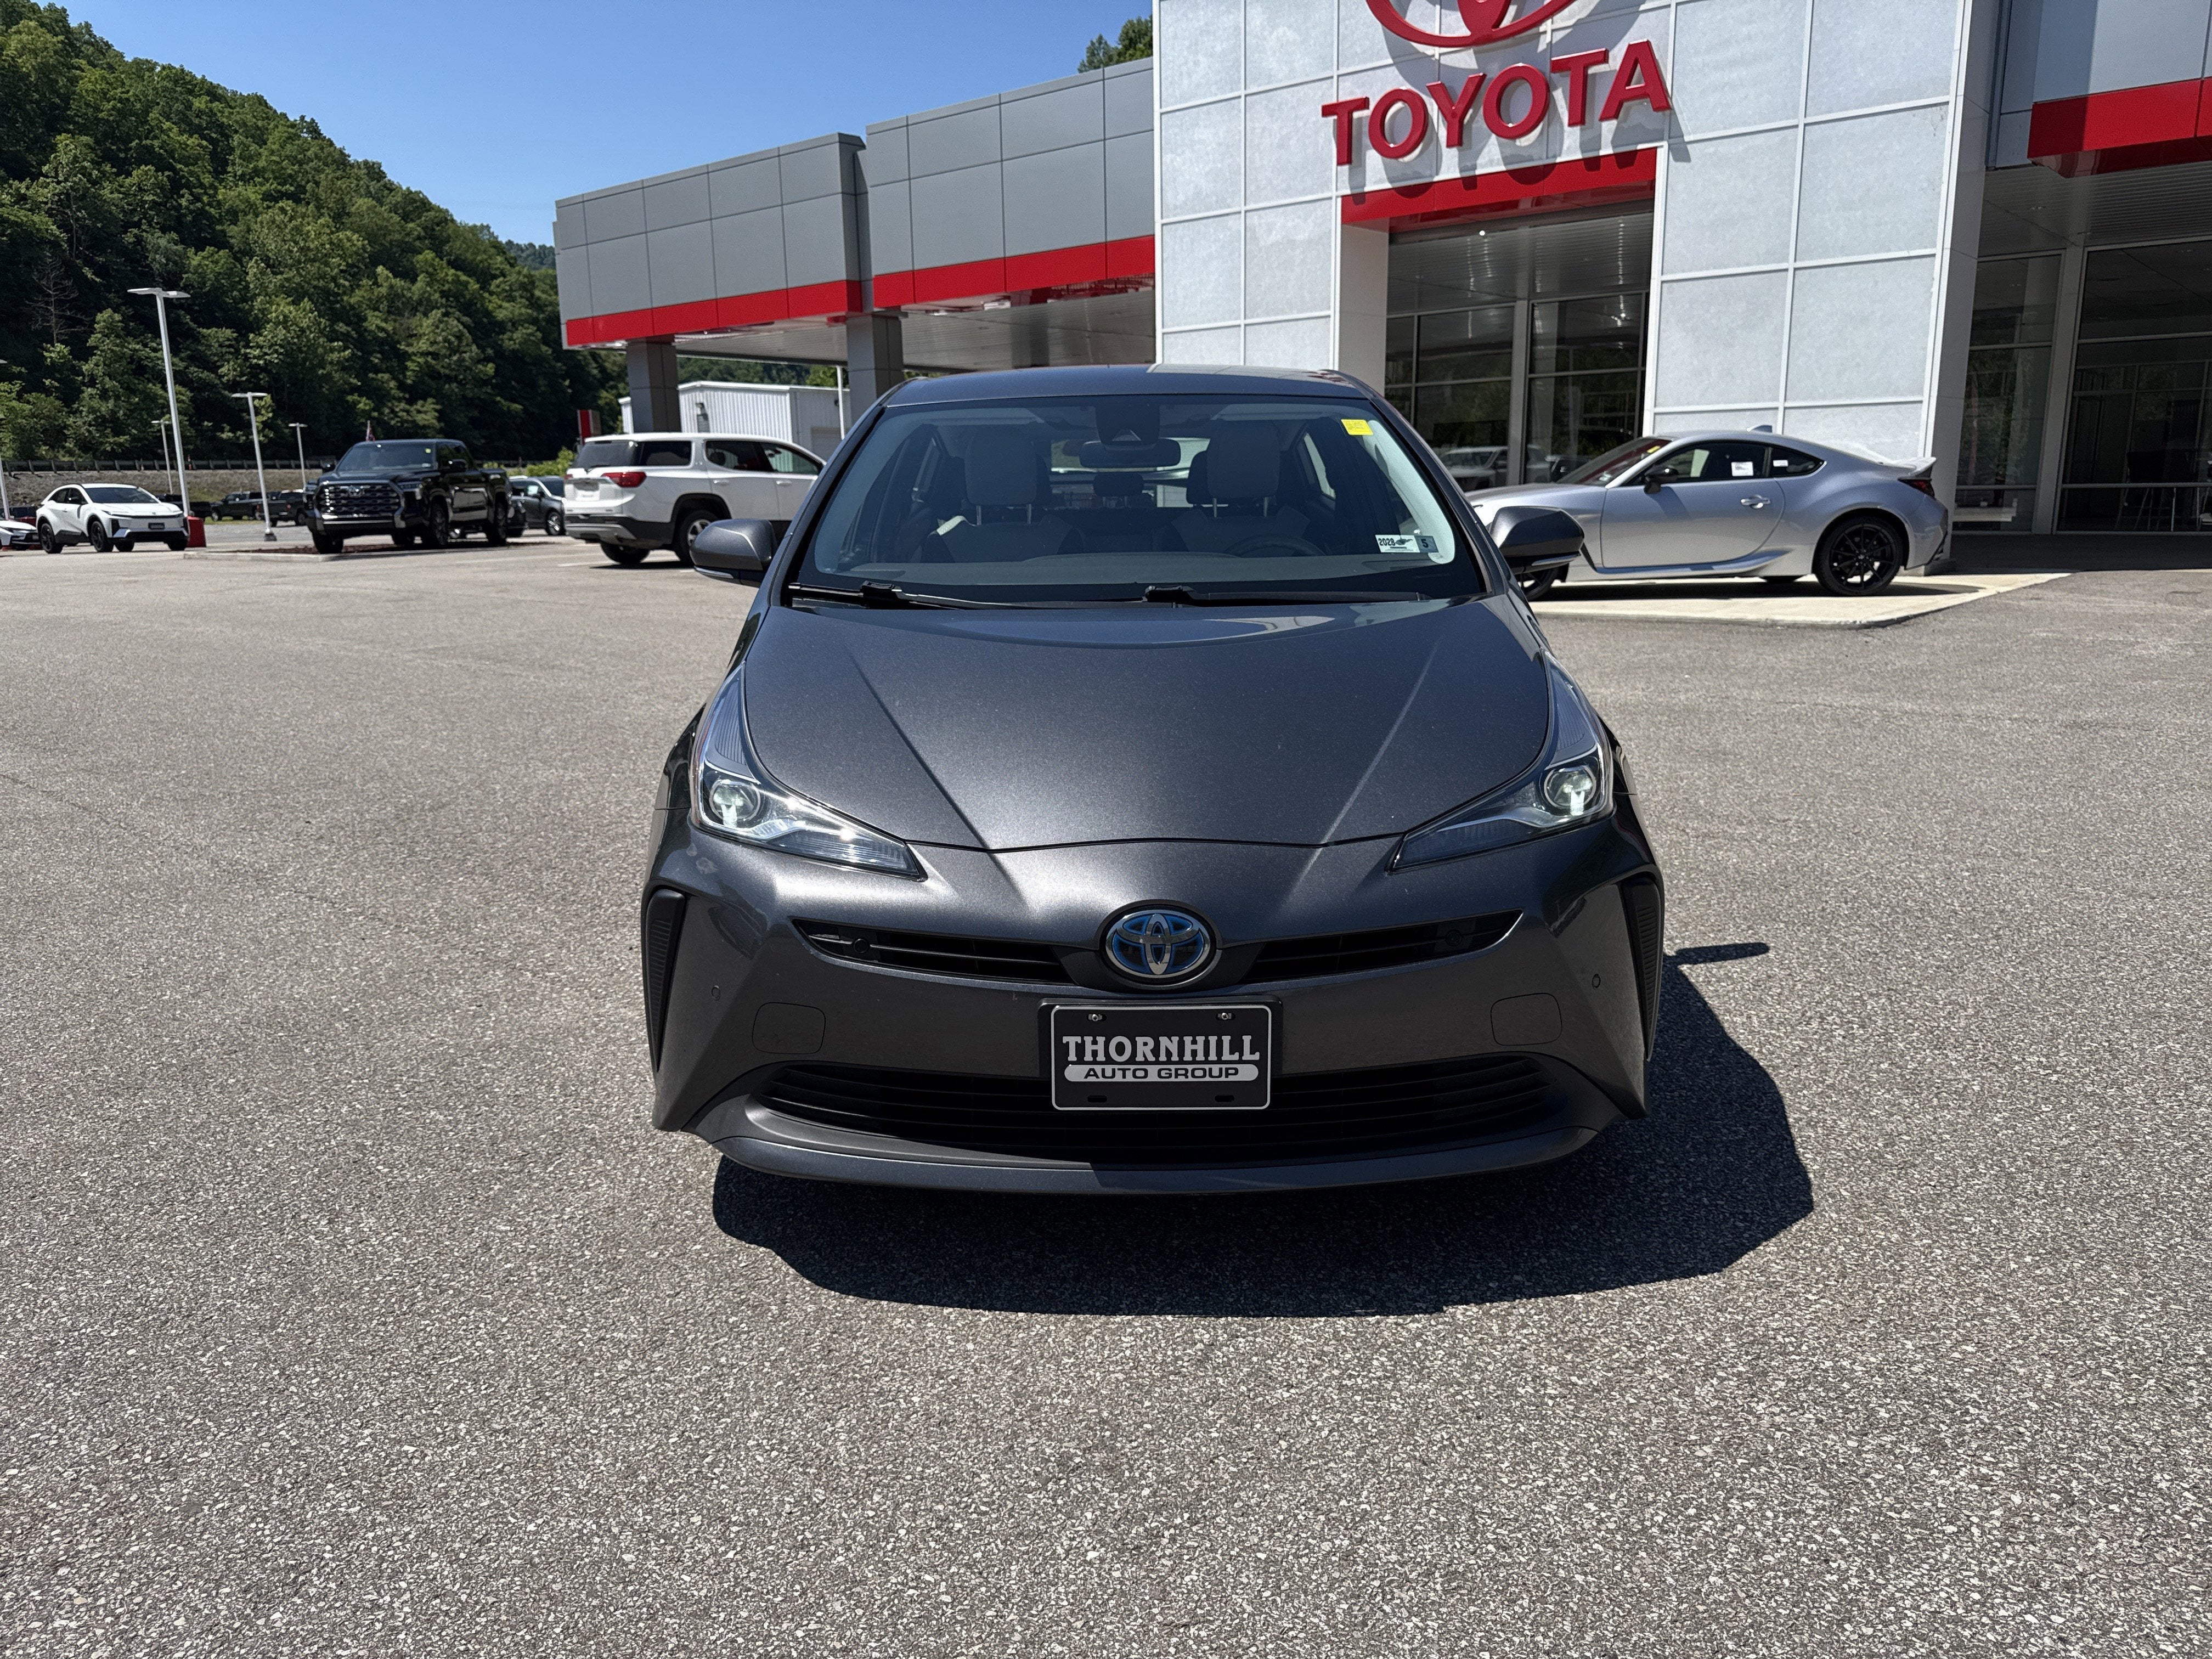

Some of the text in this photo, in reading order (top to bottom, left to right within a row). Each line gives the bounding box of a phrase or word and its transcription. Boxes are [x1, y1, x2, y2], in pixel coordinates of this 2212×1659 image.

[1321, 39, 1672, 166] TOYOTA
[1378, 538, 1429, 548] 2028 5
[1062, 1035, 1260, 1062] THORNHILL
[1083, 1066, 1239, 1079] AUTO GROUP
